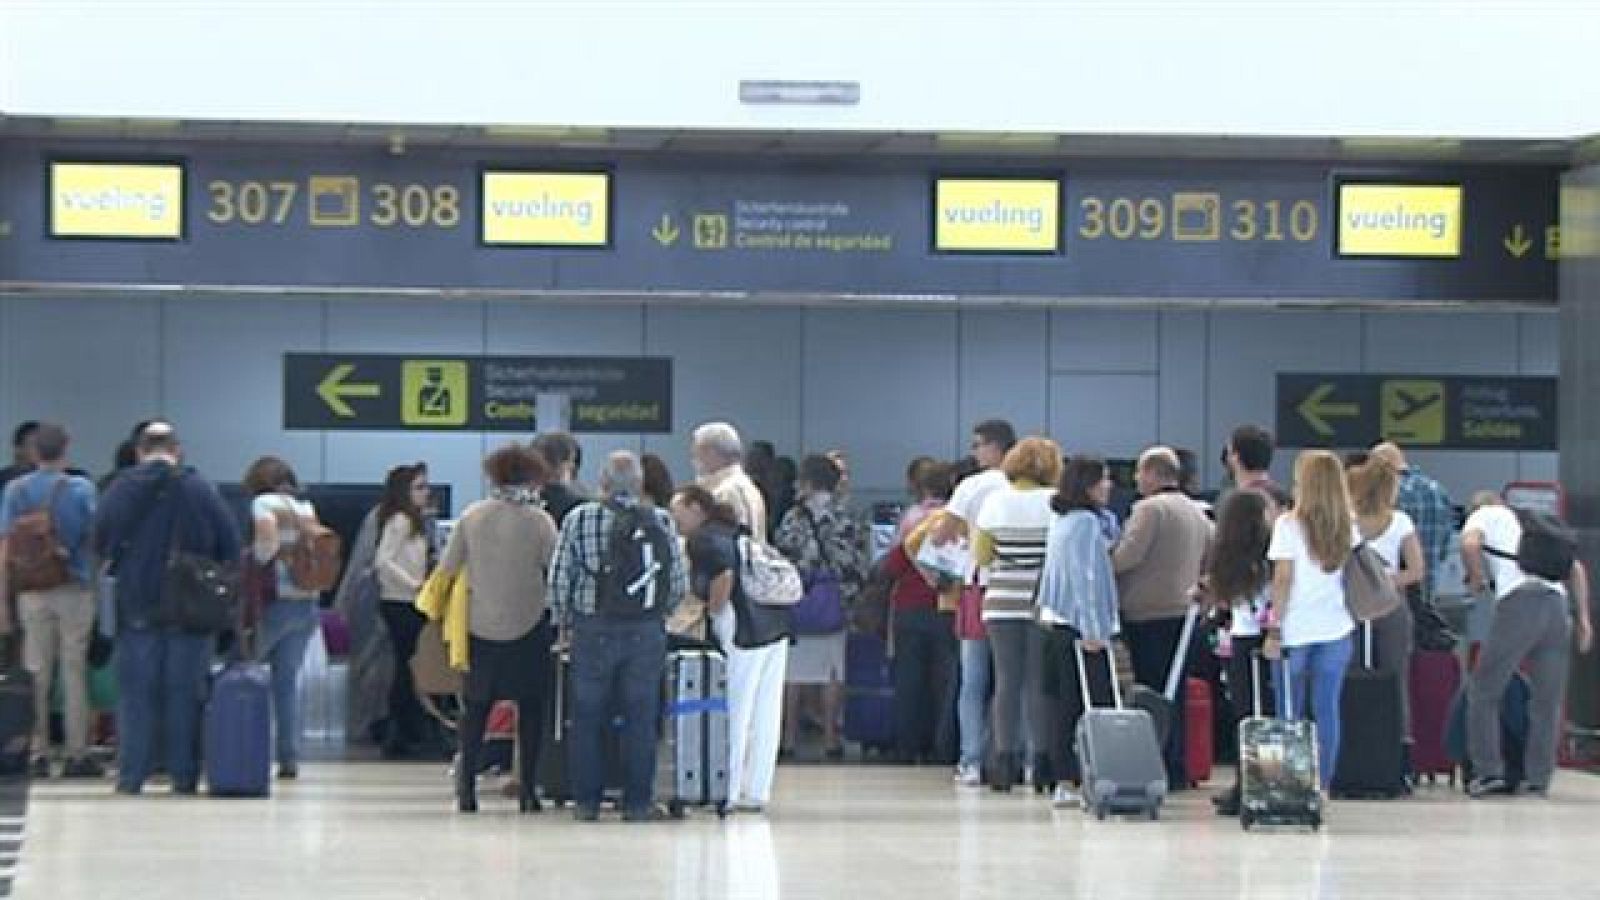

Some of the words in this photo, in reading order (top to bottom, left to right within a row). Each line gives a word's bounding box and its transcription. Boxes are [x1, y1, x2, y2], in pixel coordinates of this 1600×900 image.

[208, 181, 298, 224] 307
[371, 184, 460, 227] 308
[491, 191, 594, 225] vueling
[944, 199, 1045, 231] vueling
[1079, 196, 1166, 240] 309
[1229, 200, 1319, 242] 310
[1347, 205, 1448, 238] vueling
[736, 233, 791, 248] Control
[816, 233, 891, 251] seguridad
